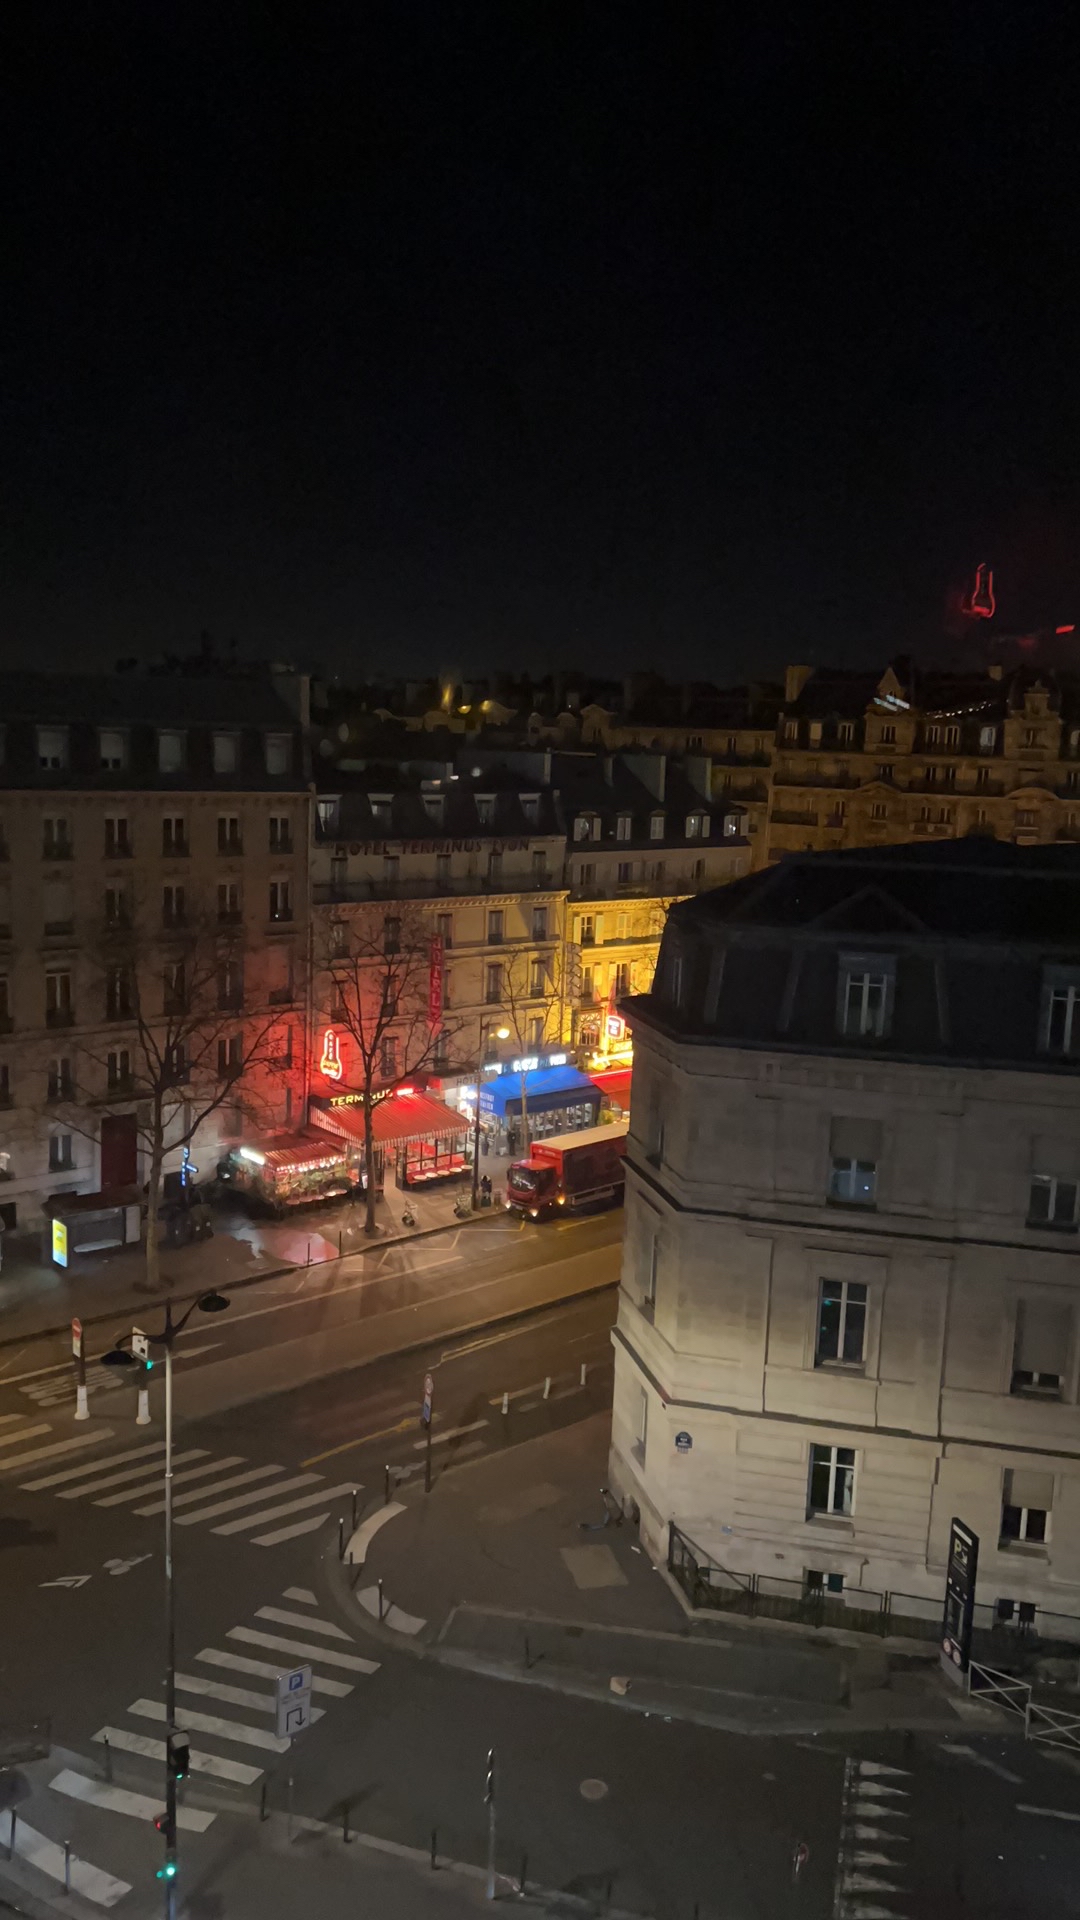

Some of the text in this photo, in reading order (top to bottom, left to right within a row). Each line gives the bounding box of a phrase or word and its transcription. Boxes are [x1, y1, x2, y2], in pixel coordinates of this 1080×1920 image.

[335, 840, 390, 857] HOTEL
[402, 838, 482, 855] TERMINUS
[330, 1089, 394, 1106] TERMUS
